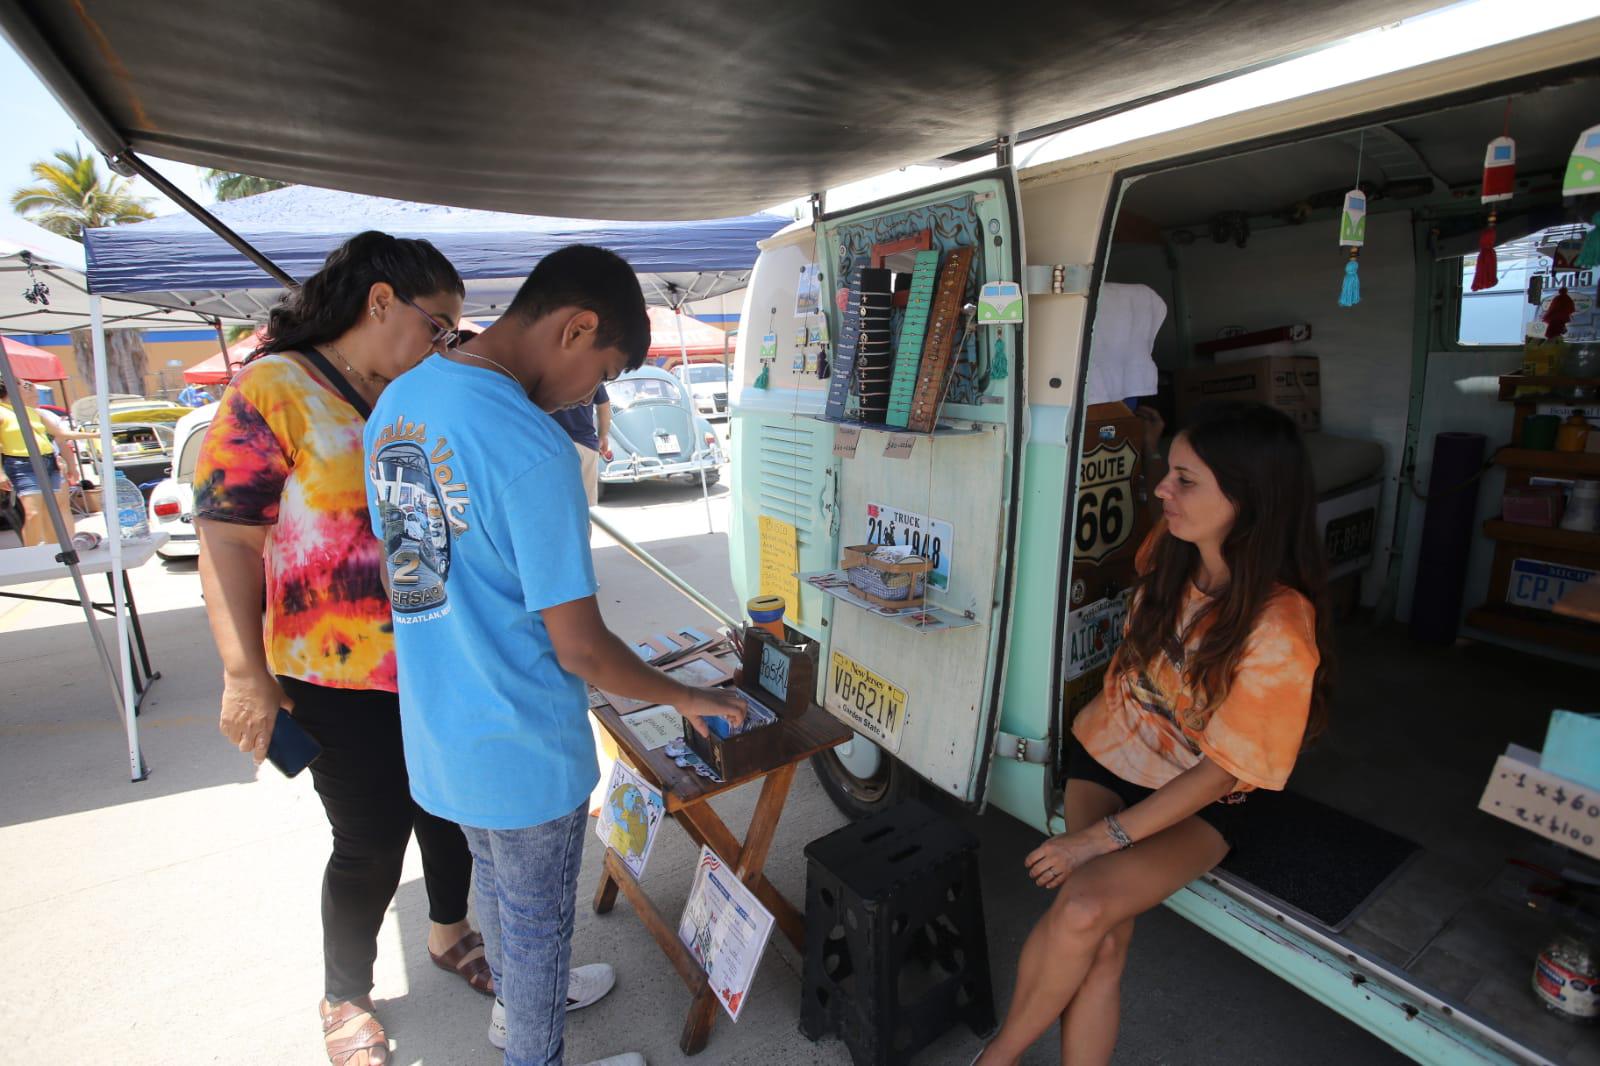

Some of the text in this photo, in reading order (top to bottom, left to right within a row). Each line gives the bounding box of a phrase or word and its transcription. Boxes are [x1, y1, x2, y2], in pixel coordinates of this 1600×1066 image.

[1081, 456, 1125, 482] ROUTE
[867, 517, 882, 545] 21
[894, 511, 920, 528] TRUCK
[1075, 487, 1123, 552] 66
[393, 551, 420, 584] 2
[842, 703, 881, 735] Garden State
